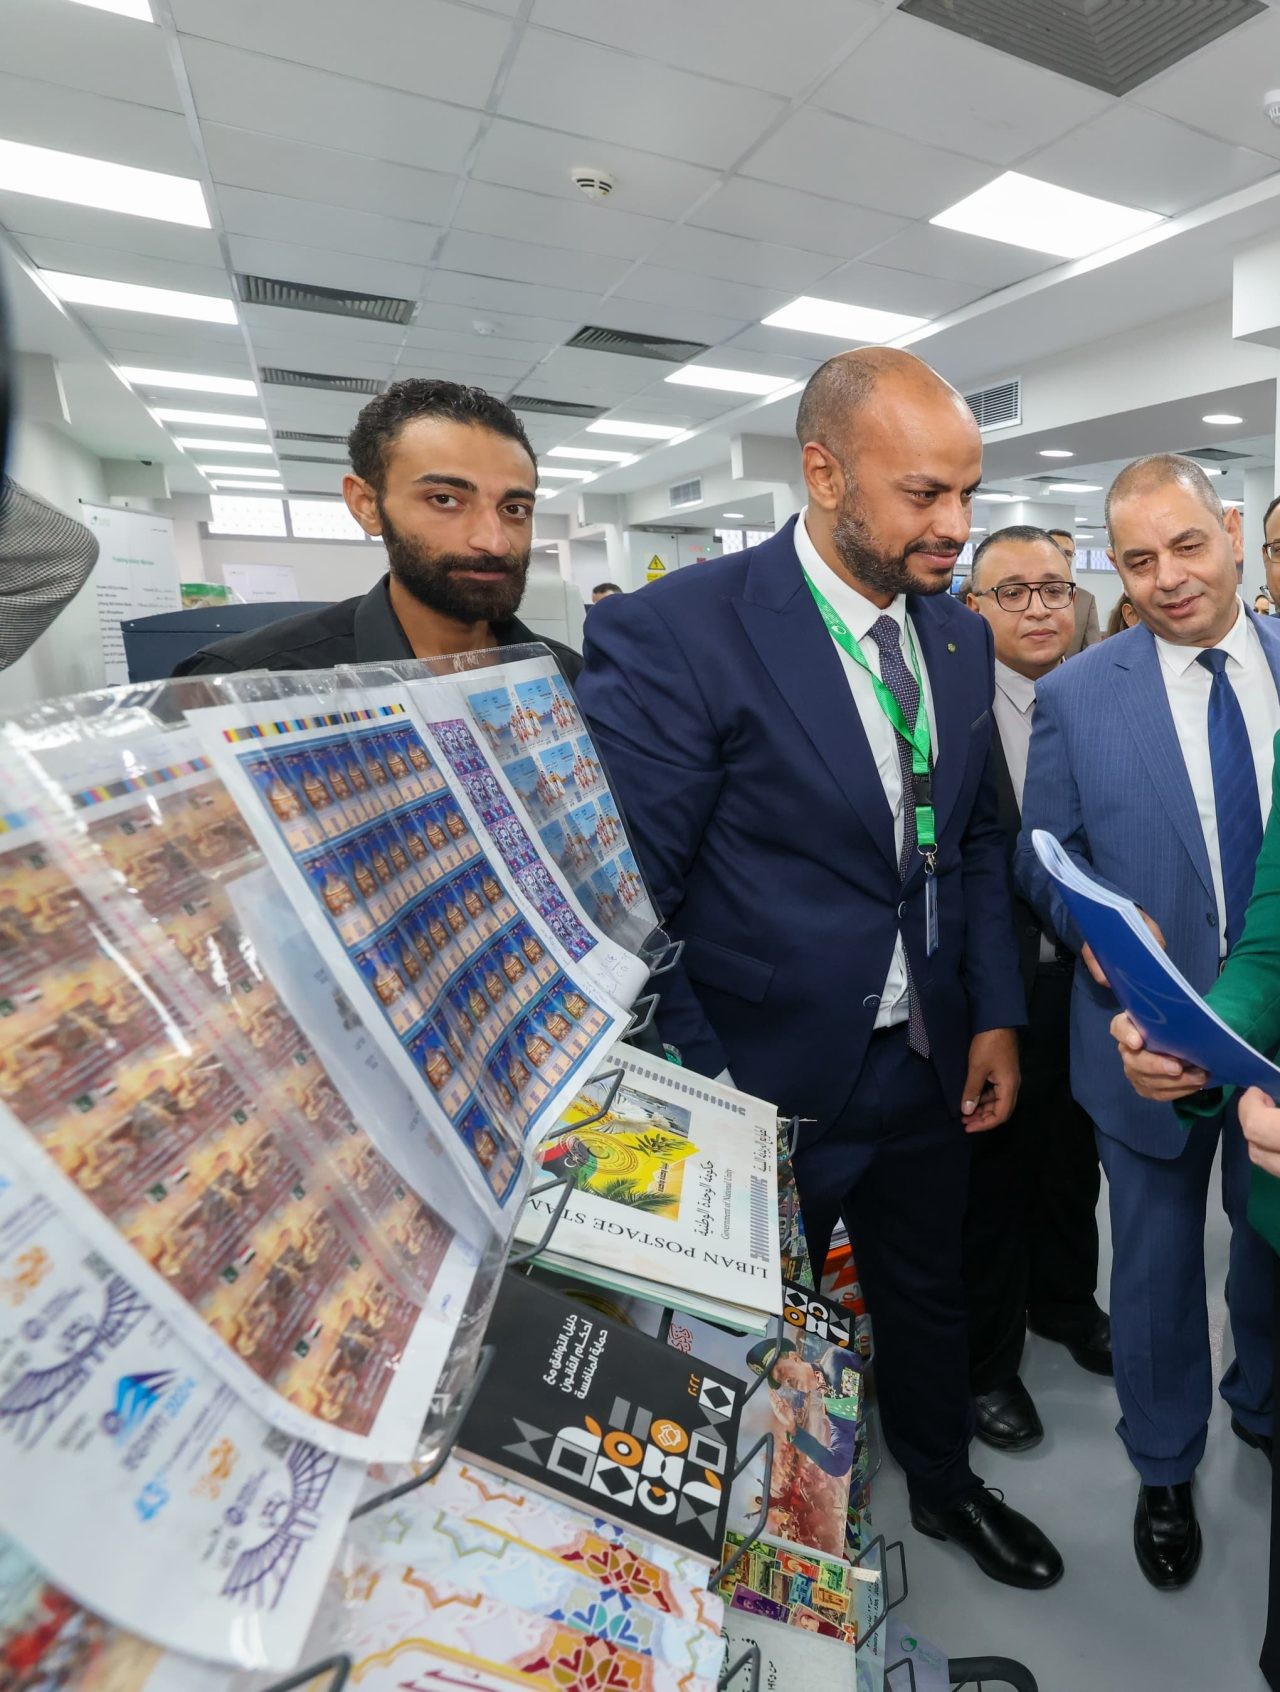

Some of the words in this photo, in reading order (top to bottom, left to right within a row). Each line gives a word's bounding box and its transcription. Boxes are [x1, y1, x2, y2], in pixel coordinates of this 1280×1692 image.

[699, 1160, 717, 1182] حكومة
[724, 1168, 734, 1182] Unity
[698, 1181, 716, 1207] الوحدة
[723, 1183, 732, 1201] National
[694, 1208, 714, 1236] الوطنية
[721, 1206, 731, 1240] Government
[593, 1217, 696, 1258] POSTAGE
[704, 1251, 768, 1279] LIBAN
[563, 1314, 578, 1337] دليل
[549, 1334, 570, 1369] التوافق
[589, 1329, 608, 1355] حماية
[543, 1368, 558, 1385] مع
[559, 1354, 580, 1393] القانون
[574, 1352, 599, 1399] المنافسة
